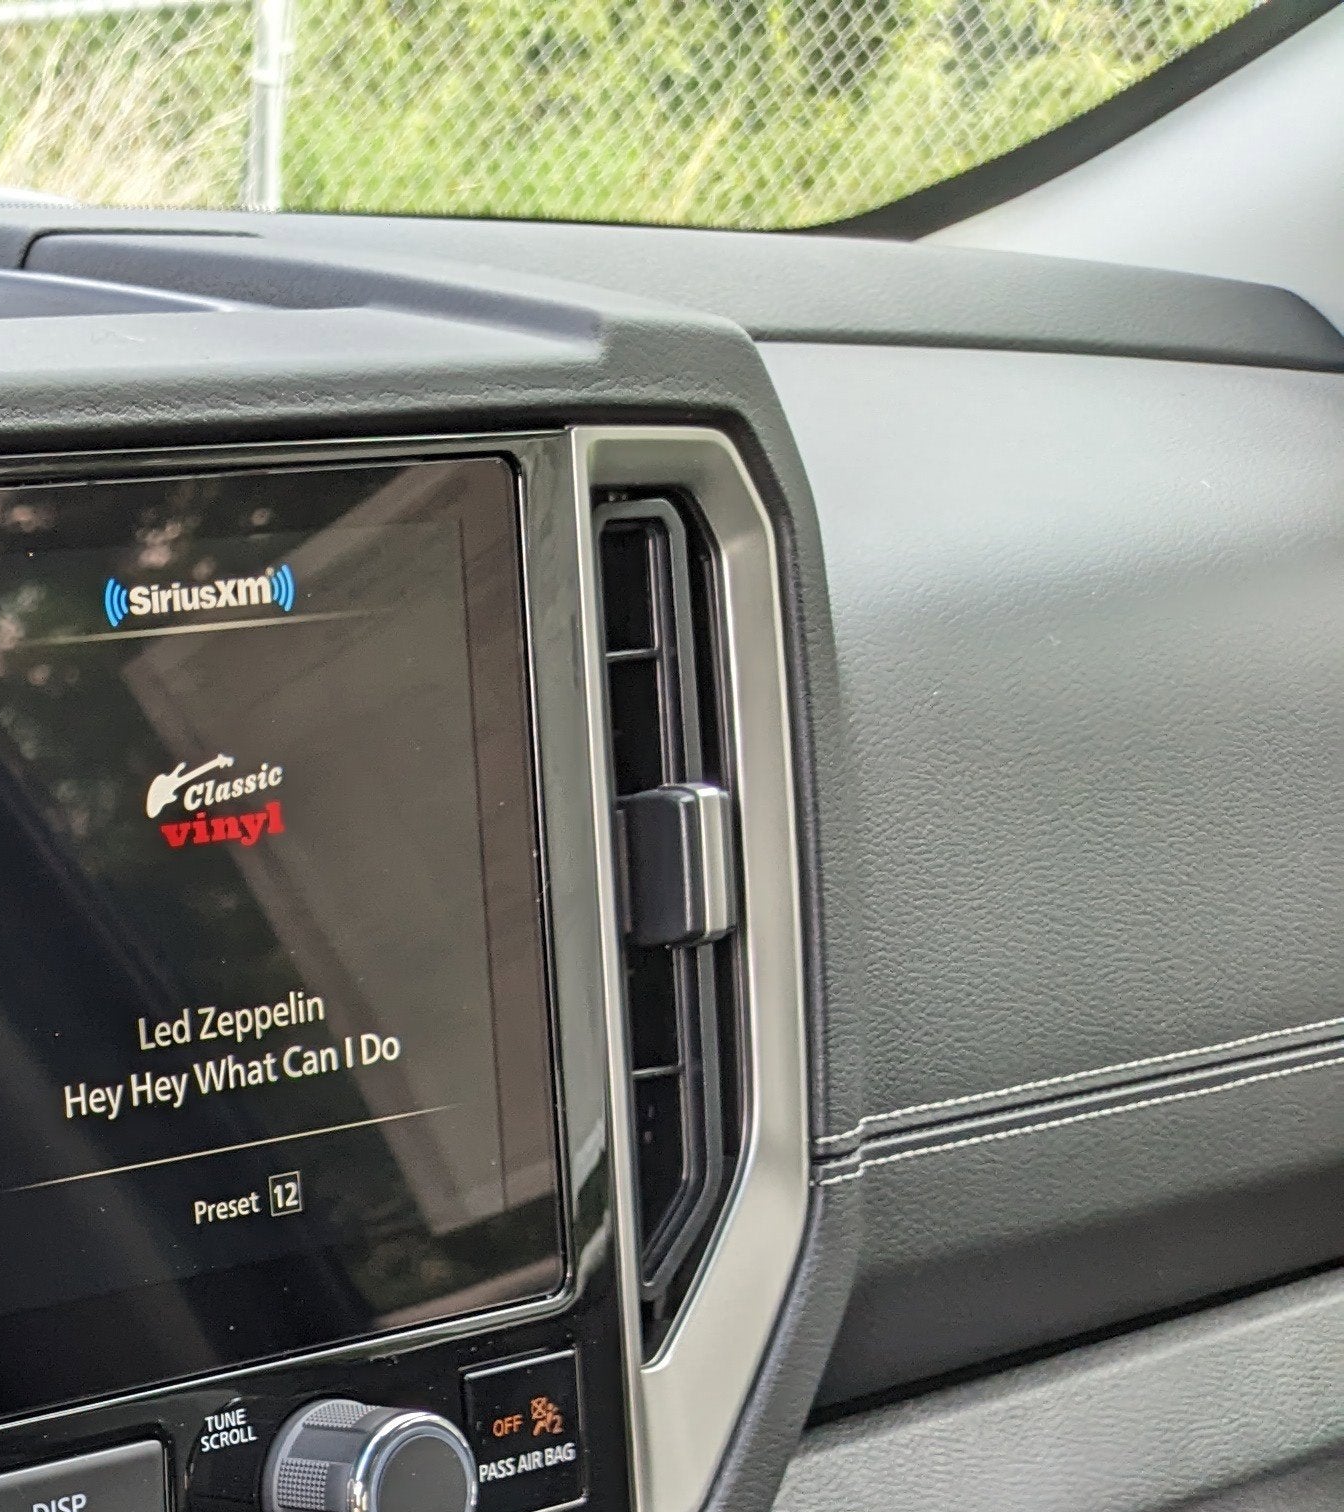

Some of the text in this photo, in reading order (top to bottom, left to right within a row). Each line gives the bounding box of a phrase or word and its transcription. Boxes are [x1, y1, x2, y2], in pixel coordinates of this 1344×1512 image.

[183, 762, 283, 812] Classic
[161, 802, 286, 848] vinyl
[138, 992, 326, 1050] Led Zeppelin
[64, 1032, 401, 1121] Hey Hey What Can I Do
[195, 1181, 299, 1225] Preset 12
[200, 1423, 257, 1453] SCROLL
[204, 1408, 247, 1434] TUNE
[492, 1414, 523, 1438] OFF
[479, 1442, 577, 1483] PASS AIR BAG
